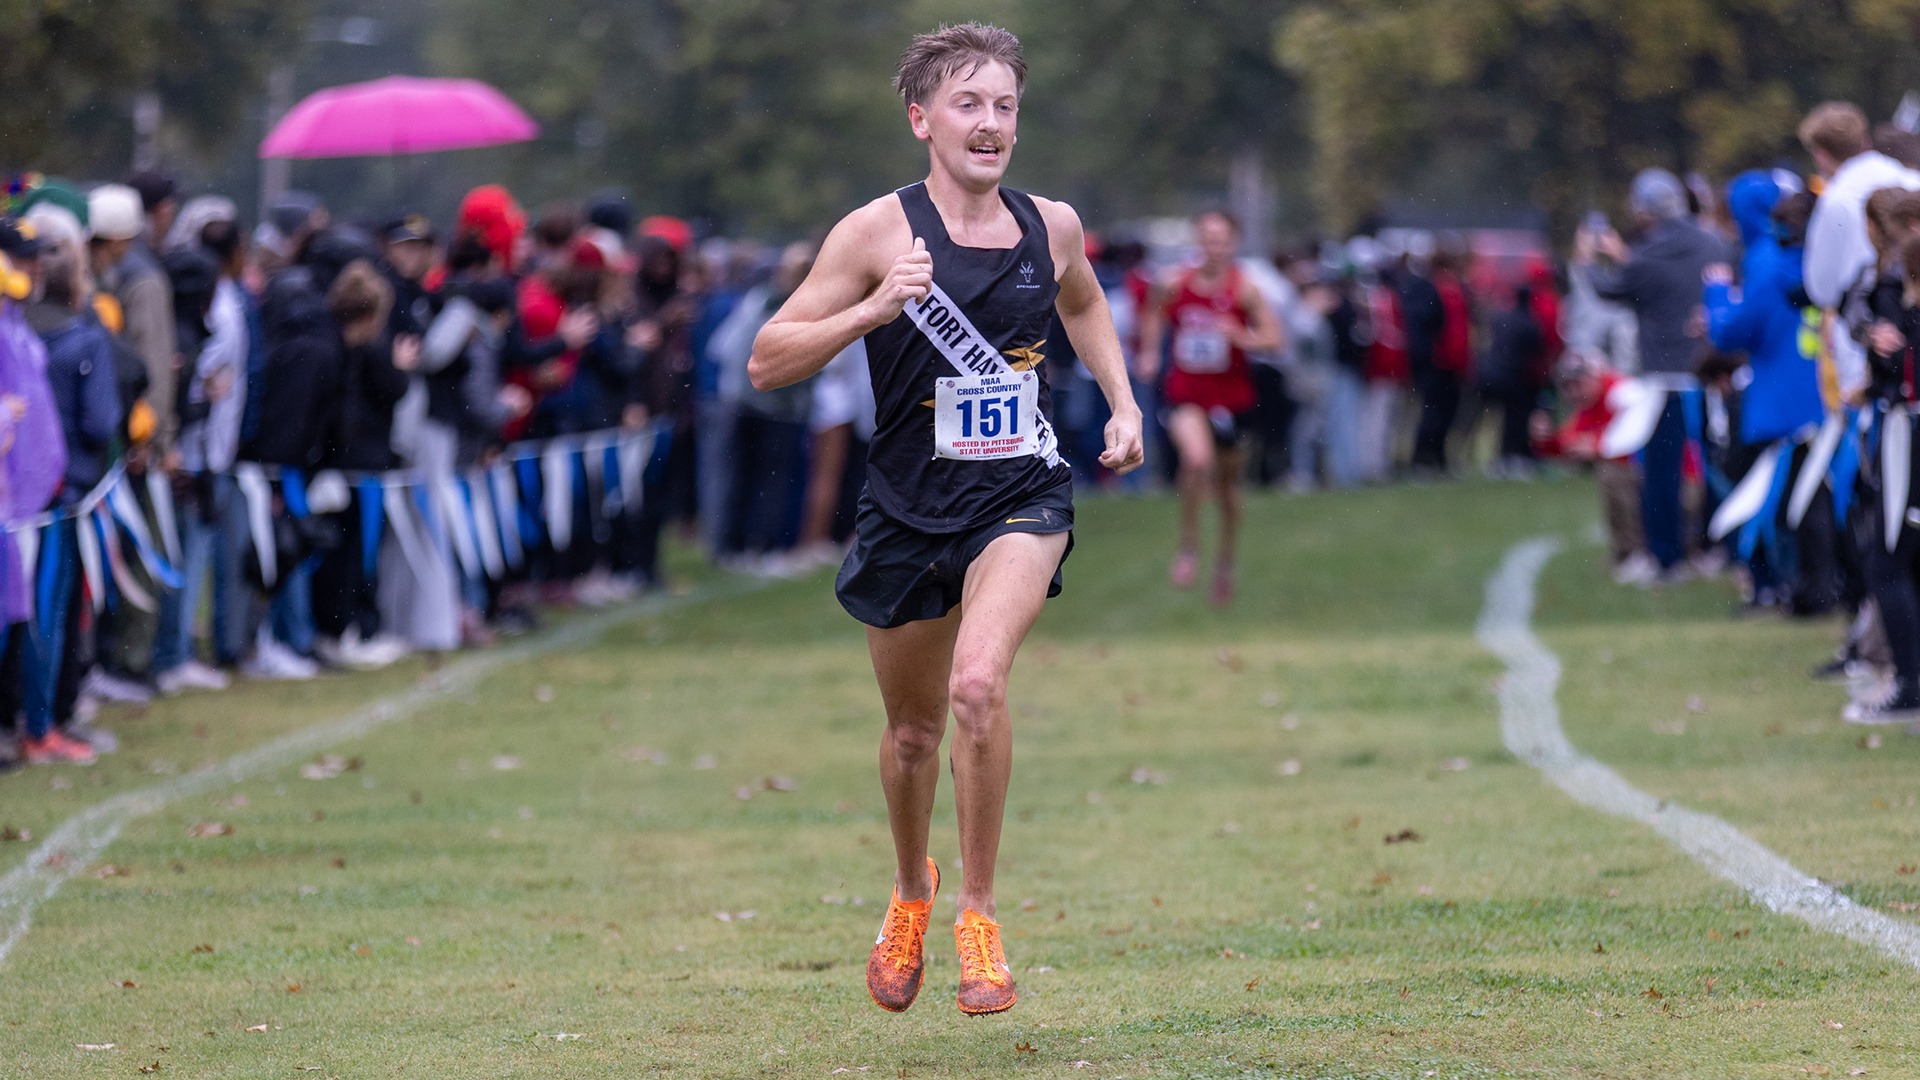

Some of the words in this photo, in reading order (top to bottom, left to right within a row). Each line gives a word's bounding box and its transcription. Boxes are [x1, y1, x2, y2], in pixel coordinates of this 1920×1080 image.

[917, 294, 971, 350] FORT
[981, 377, 1000, 386] MIAA
[957, 387, 985, 396] CROSS
[986, 383, 1022, 393] COUNTRY
[956, 396, 1019, 438] 151
[983, 445, 1019, 454] UNIVERSITY
